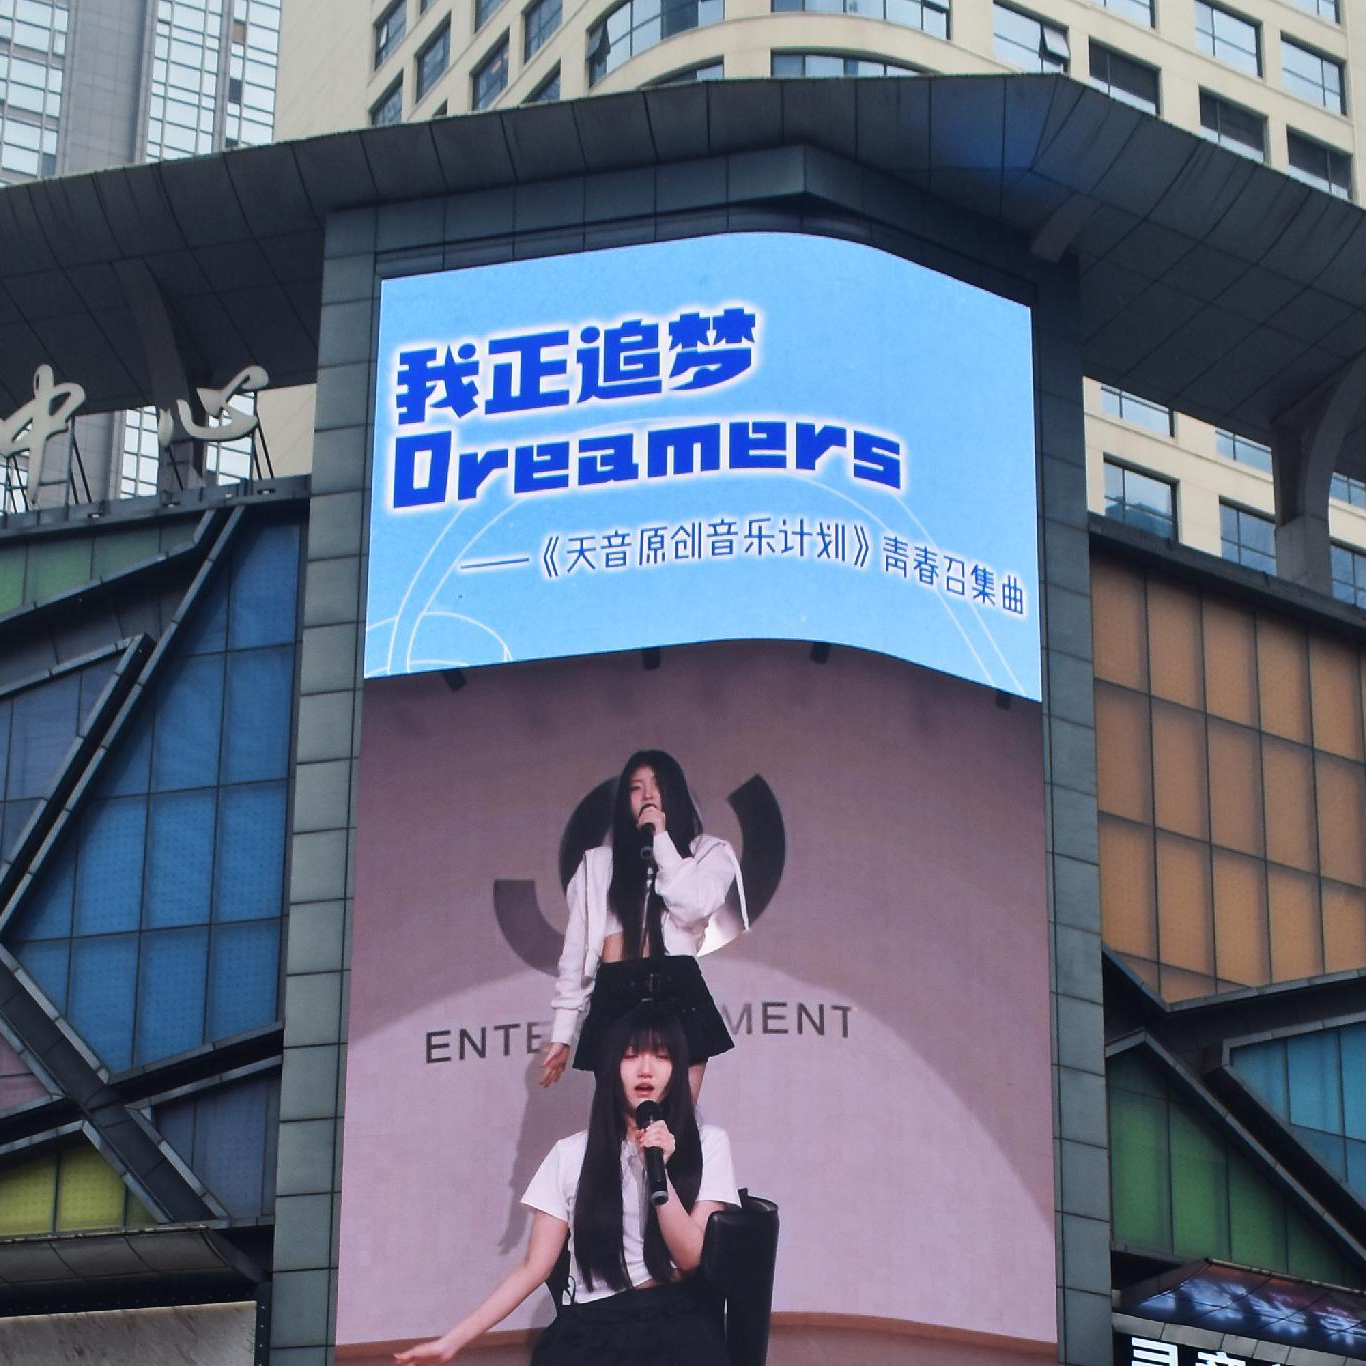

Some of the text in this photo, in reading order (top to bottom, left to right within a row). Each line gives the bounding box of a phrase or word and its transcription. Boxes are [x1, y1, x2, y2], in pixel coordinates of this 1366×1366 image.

[395, 306, 756, 425] 我正追梦
[392, 420, 902, 510] Dreamers
